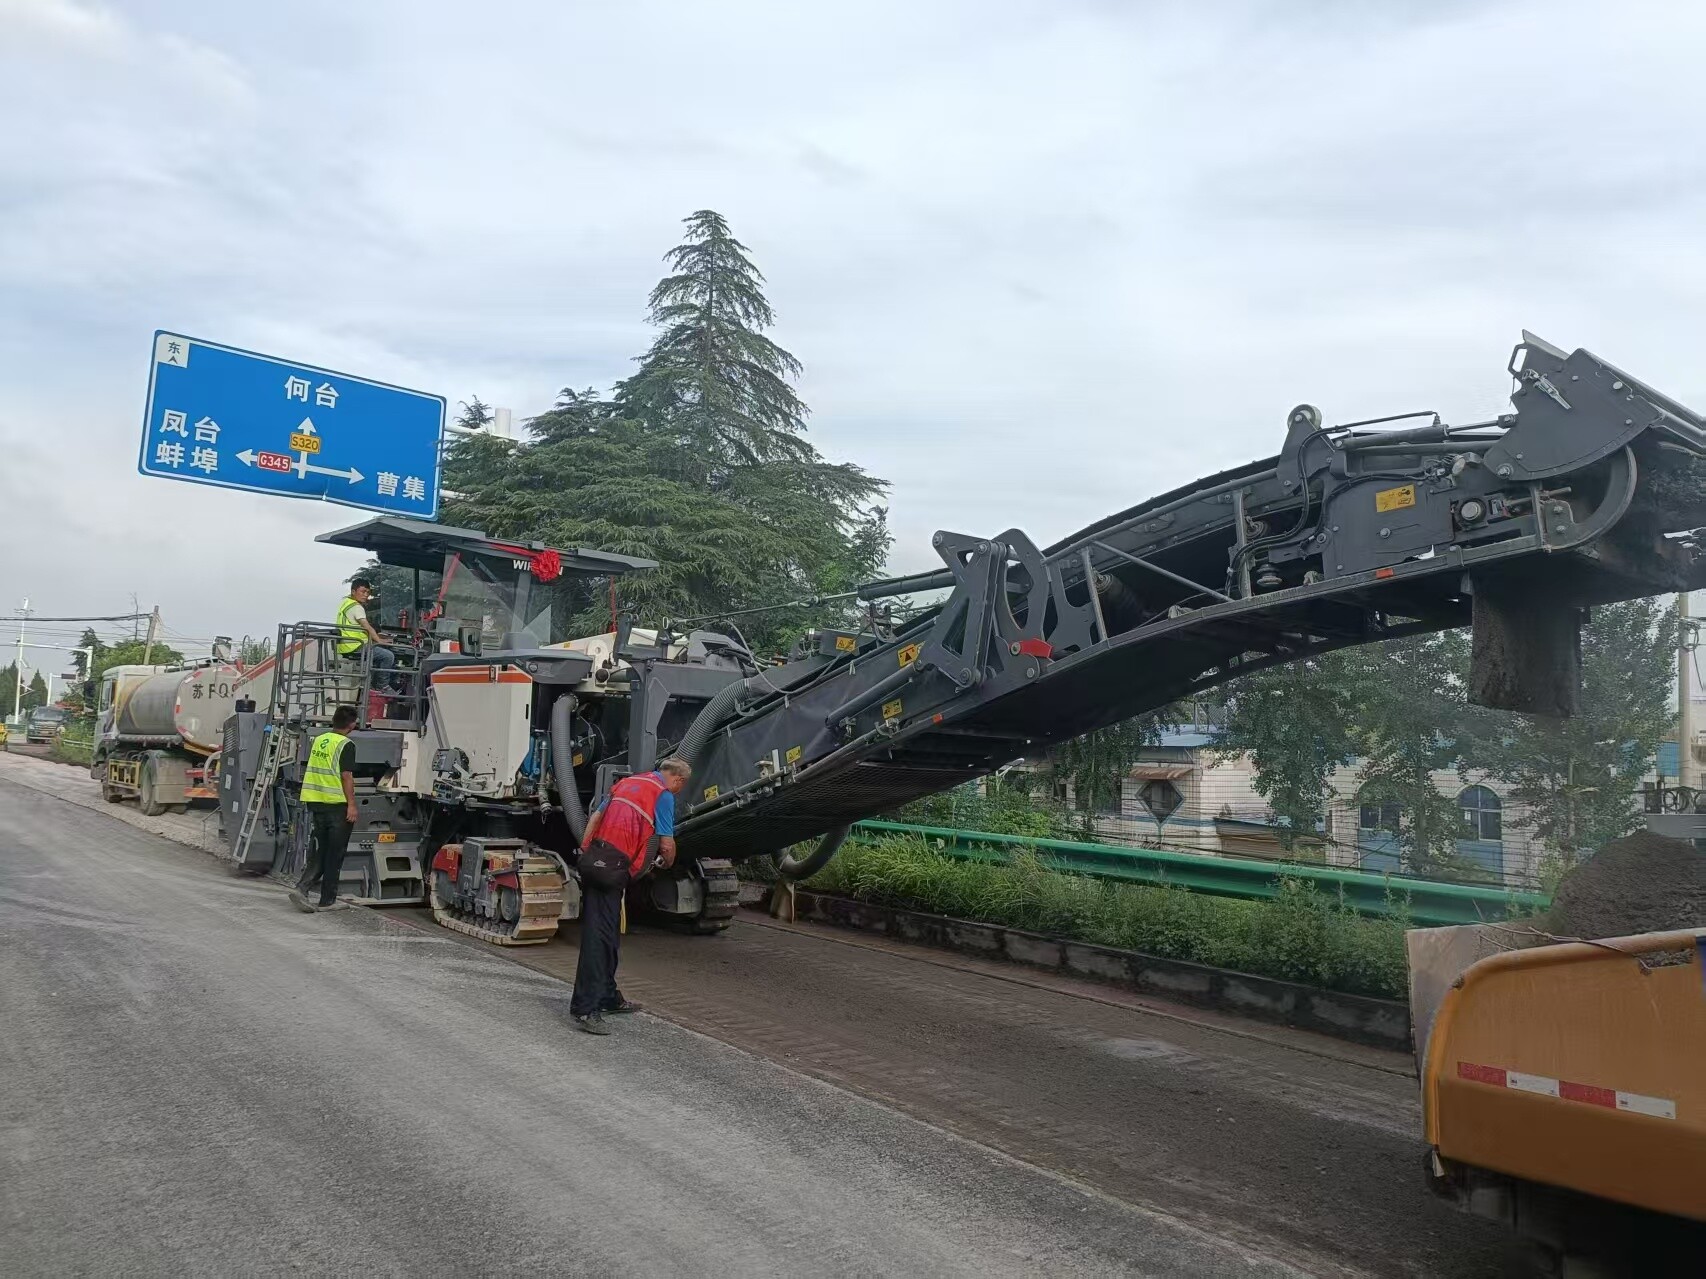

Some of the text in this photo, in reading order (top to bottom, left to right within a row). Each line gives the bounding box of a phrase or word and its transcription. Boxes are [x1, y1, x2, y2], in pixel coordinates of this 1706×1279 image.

[168, 341, 181, 355] 东
[284, 375, 340, 409] 何台
[159, 408, 221, 444] 凤台
[155, 440, 218, 474] 蚌埠
[291, 435, 319, 451] S320
[260, 454, 289, 470] G345
[376, 471, 426, 501] 曹集
